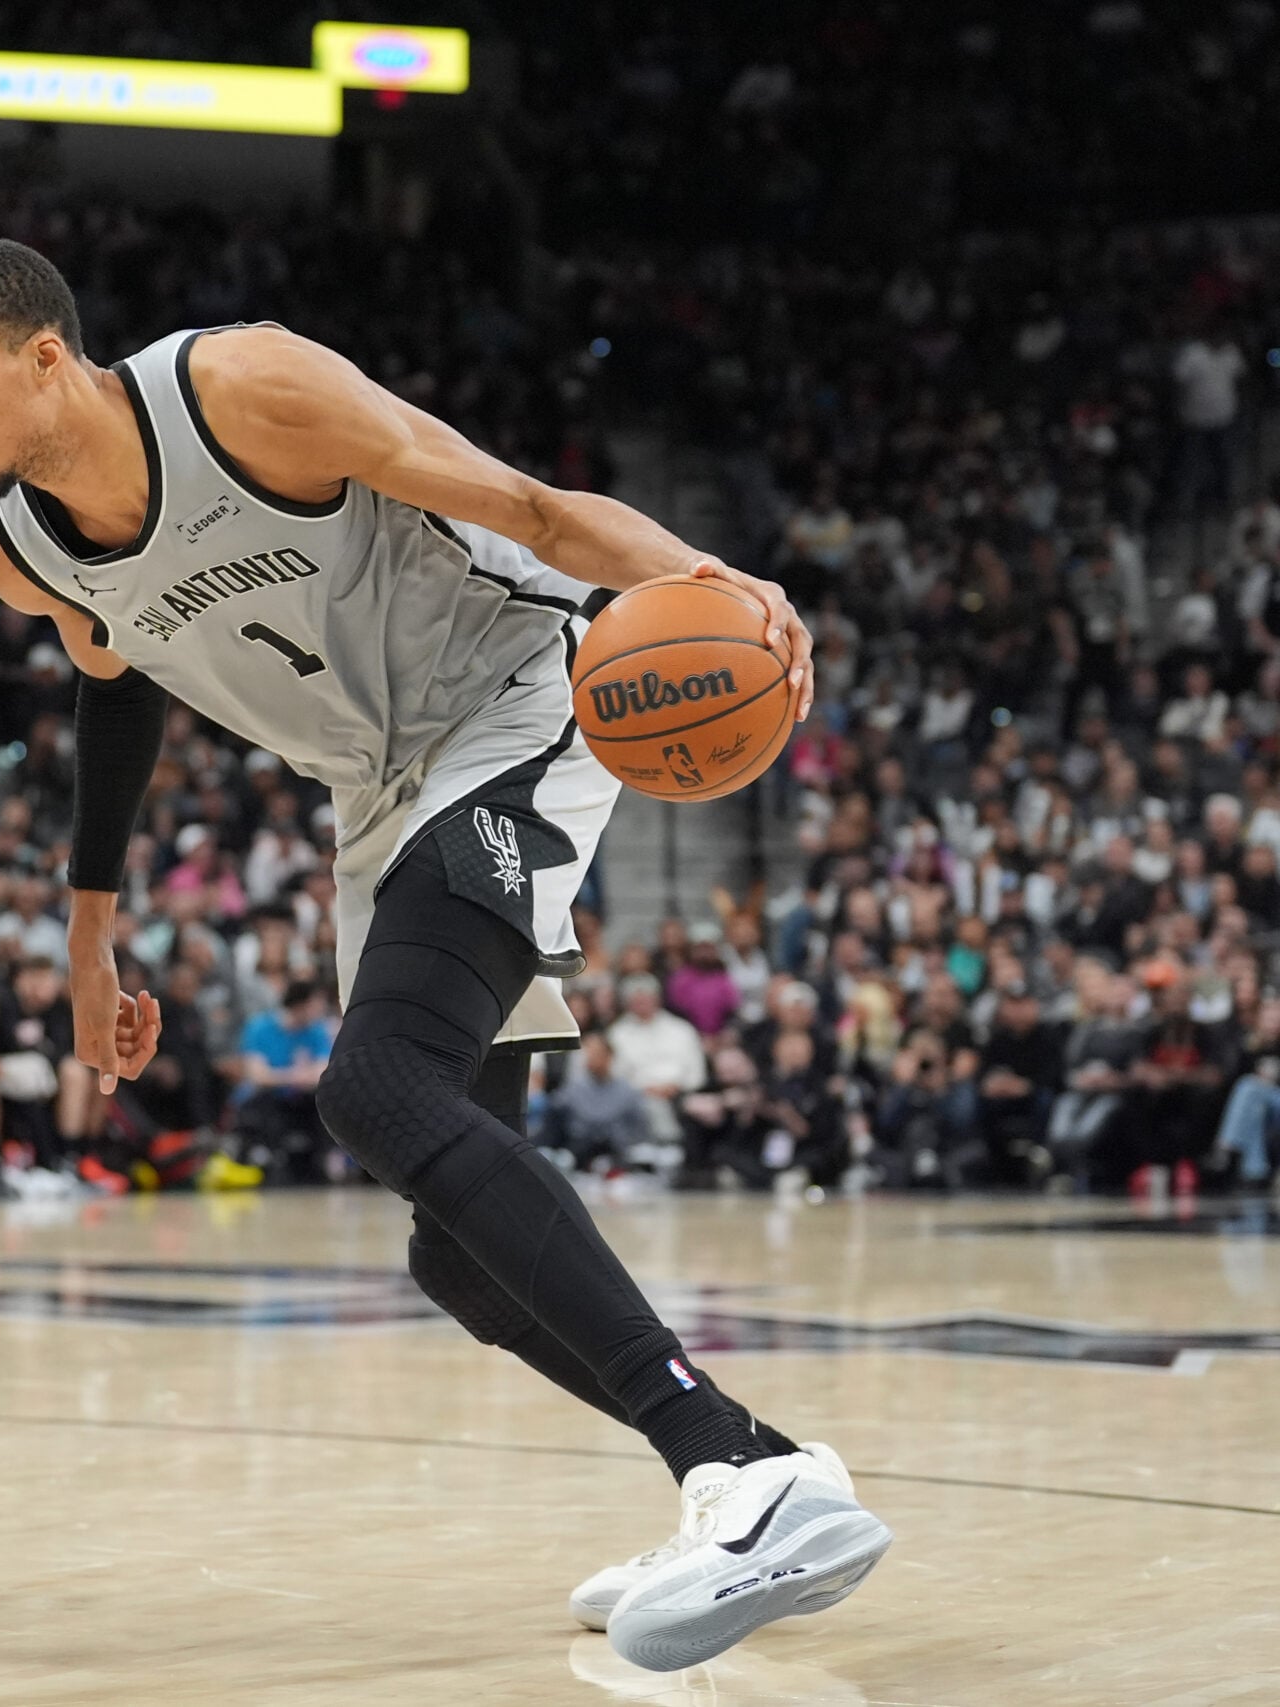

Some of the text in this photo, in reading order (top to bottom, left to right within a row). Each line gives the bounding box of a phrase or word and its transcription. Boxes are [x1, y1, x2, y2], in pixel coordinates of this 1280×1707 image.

[186, 505, 229, 536] LEDGER
[132, 546, 322, 643] SAN ANTONIO
[238, 619, 328, 680] 1
[590, 668, 738, 724] Wilson
